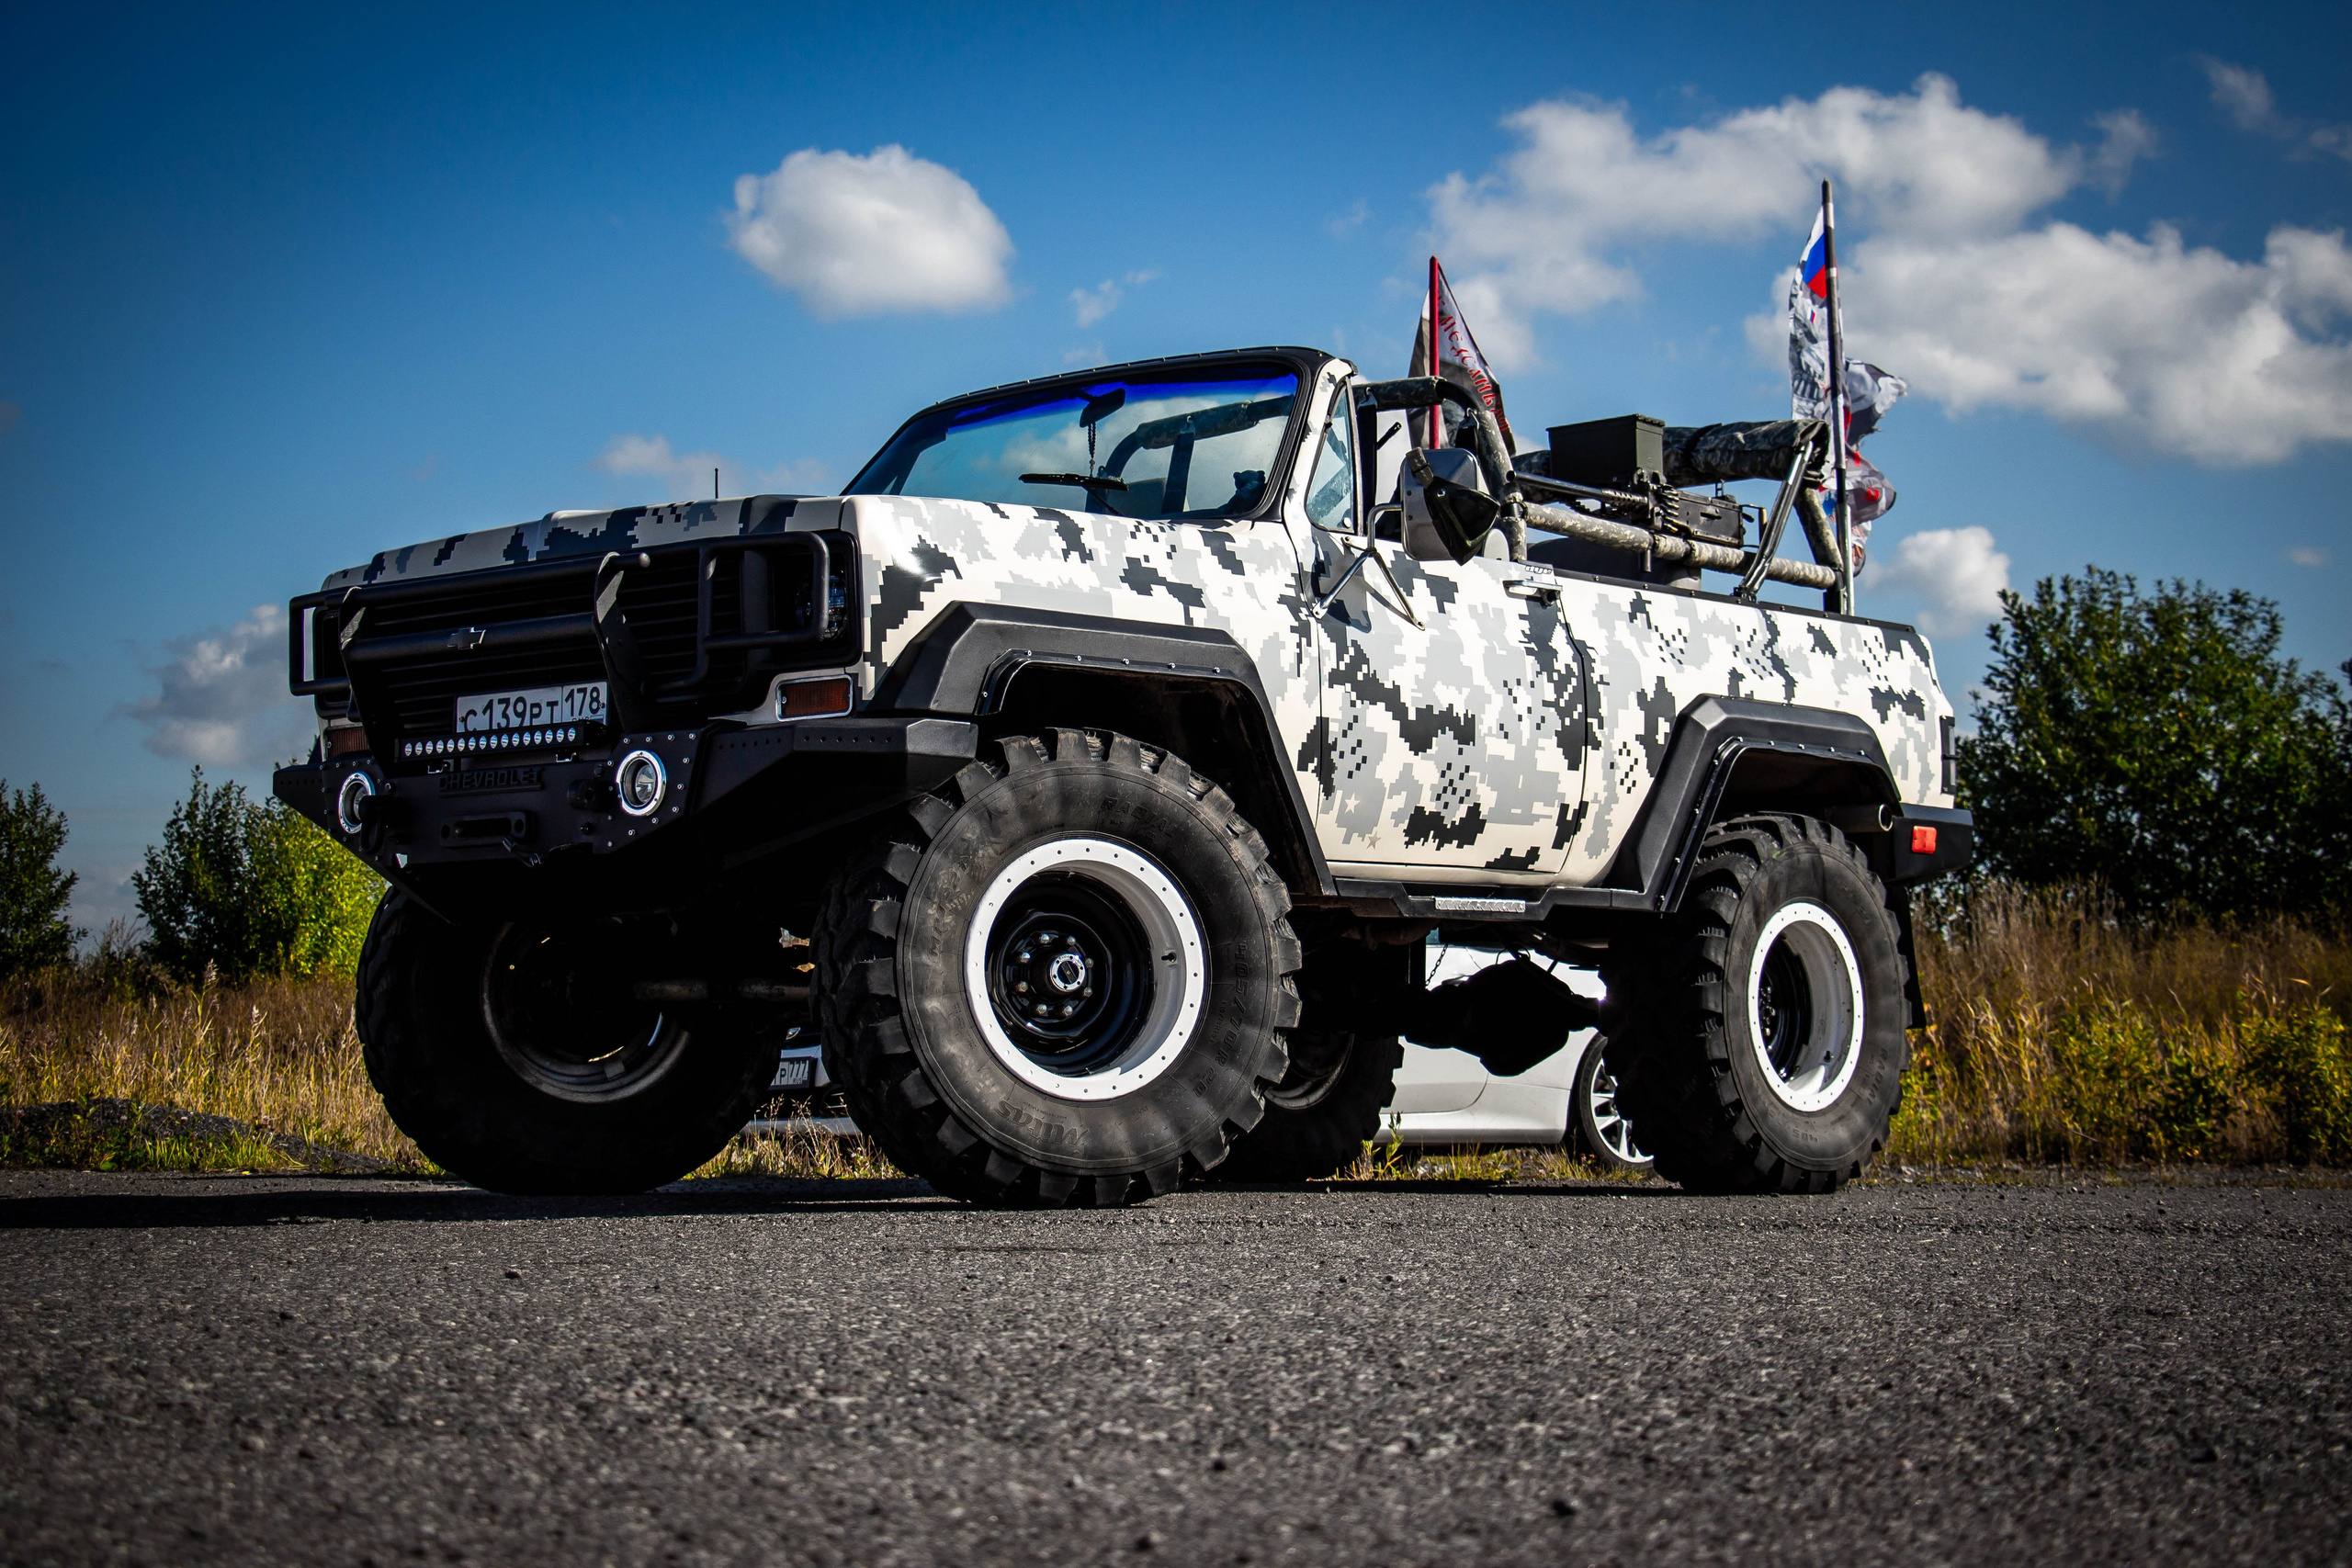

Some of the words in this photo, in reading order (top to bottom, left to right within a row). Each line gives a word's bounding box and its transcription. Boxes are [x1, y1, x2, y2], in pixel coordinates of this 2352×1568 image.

[564, 686, 601, 716] 178
[438, 768, 540, 790] CHEVROLET
[789, 1060, 807, 1077] 777
[995, 1100, 1090, 1146] Mitas
